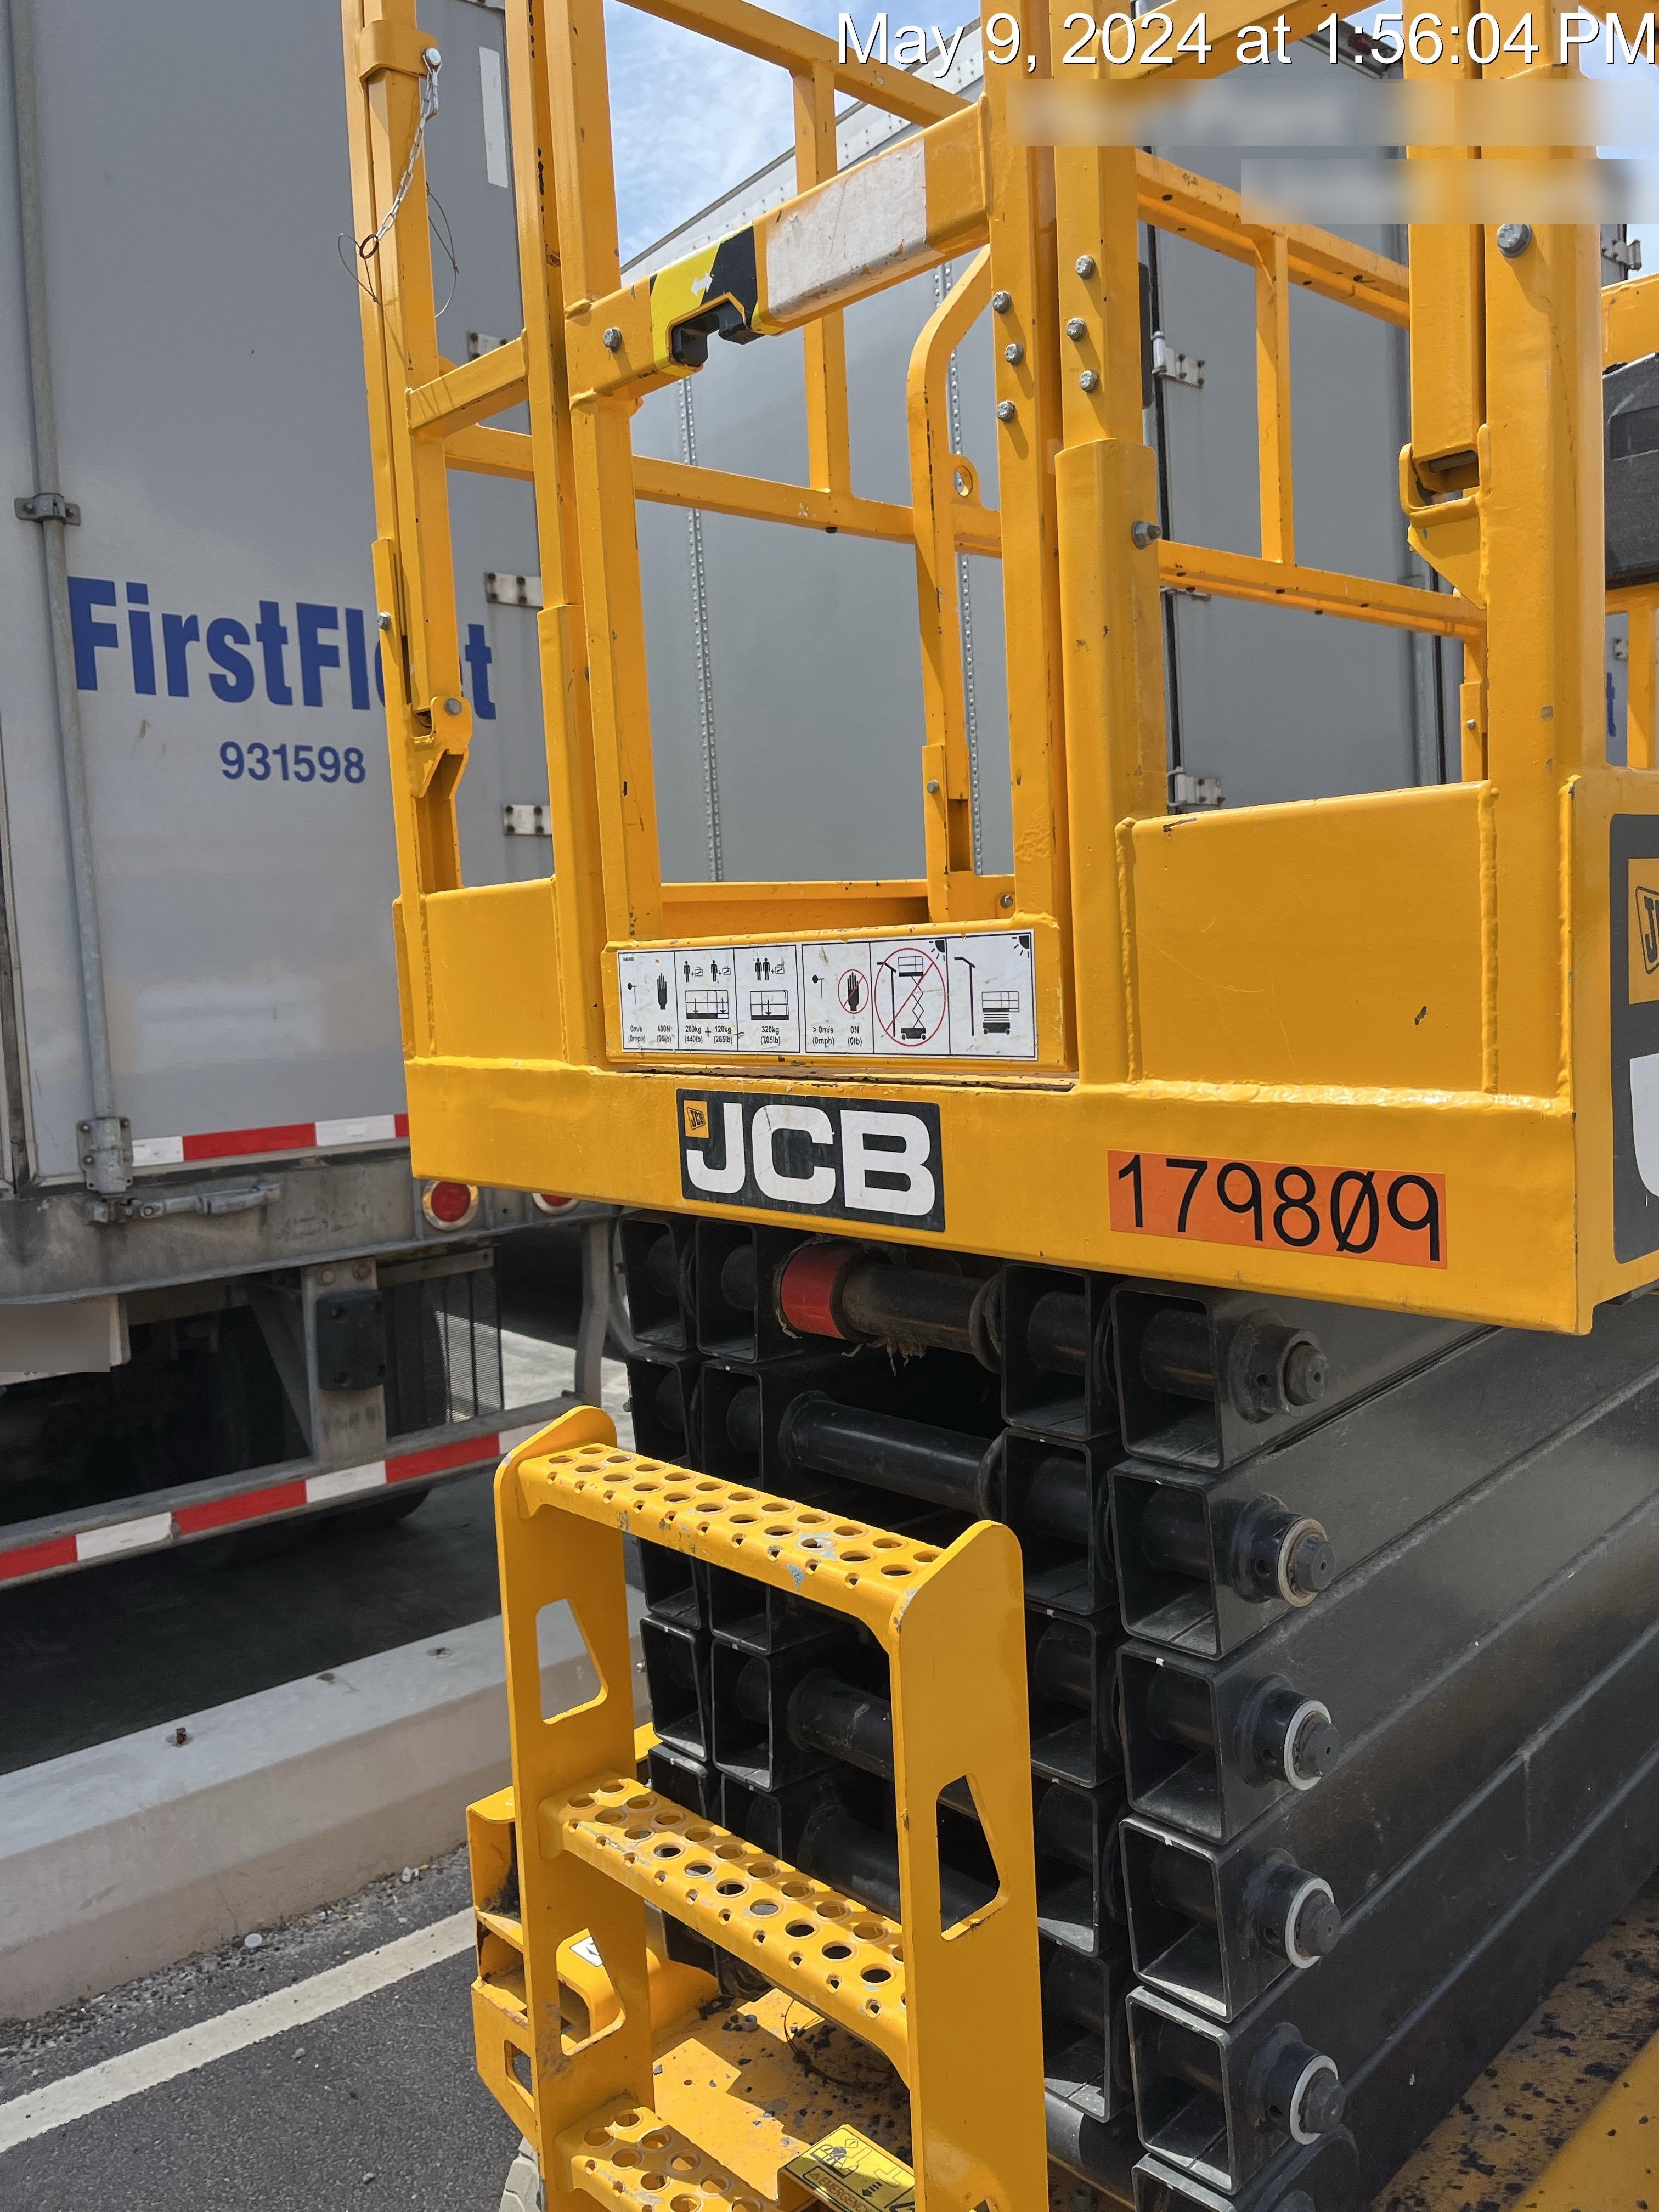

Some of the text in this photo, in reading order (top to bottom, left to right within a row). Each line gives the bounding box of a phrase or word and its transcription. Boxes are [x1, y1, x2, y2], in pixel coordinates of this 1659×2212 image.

[67, 575, 496, 720] FirstFlt
[220, 741, 366, 785] 931598
[685, 1025, 702, 1034] 200kg
[715, 1025, 731, 1034] 120kg
[761, 1025, 780, 1035] 320kg
[819, 1025, 834, 1034] 0m/s
[628, 1035, 646, 1043] (0mph)
[684, 1035, 703, 1044] (440lb)
[713, 1036, 732, 1045] (265lb)
[812, 1036, 834, 1046] (0mph)
[848, 1037, 862, 1047] (0lb)
[690, 1110, 704, 1127] JCB
[686, 1102, 935, 1216] JCB
[1118, 1154, 1440, 1262] 179809
